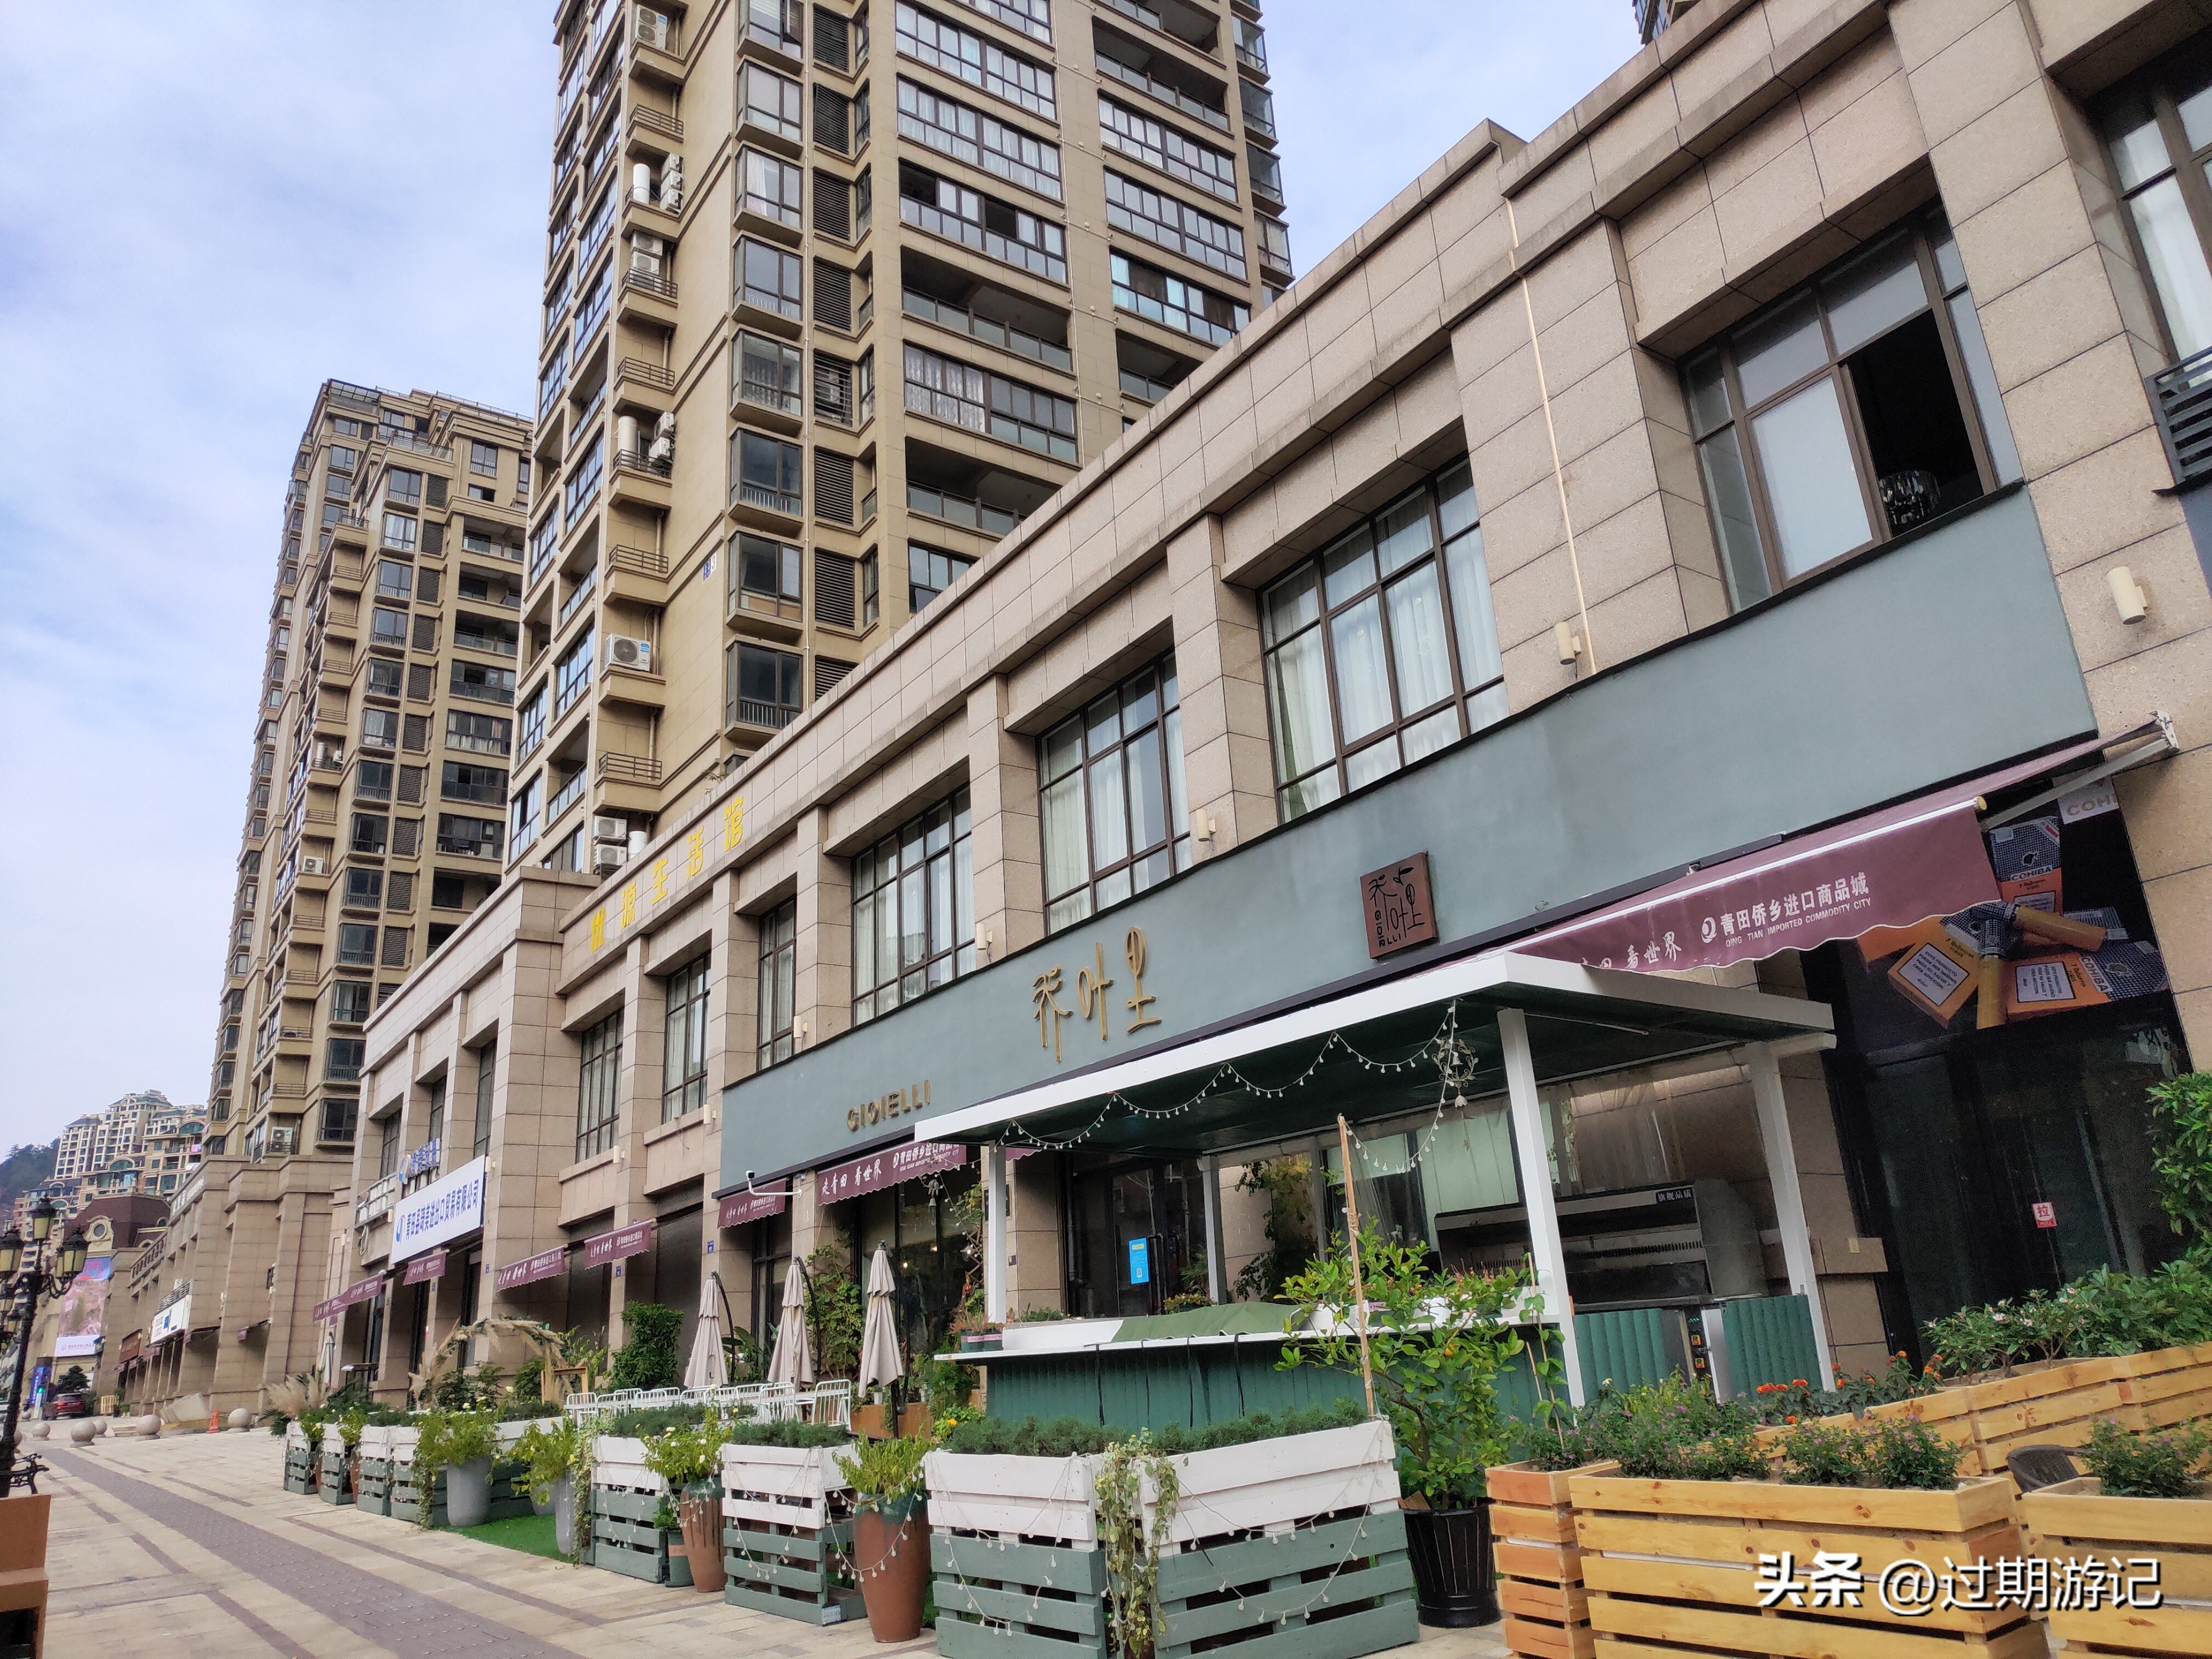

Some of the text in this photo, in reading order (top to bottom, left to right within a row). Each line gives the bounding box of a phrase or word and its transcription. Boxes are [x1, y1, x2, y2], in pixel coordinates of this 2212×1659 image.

[2011, 866, 2052, 882] COHIBA
[1720, 872, 1869, 936] 青田侨乡进口商品城
[1746, 929, 1764, 941] TIAN
[1767, 918, 1803, 935] IMPORTED
[1805, 902, 1851, 924] COMMODITY
[1853, 897, 1872, 910] CITY
[1625, 931, 1683, 969] 看世界
[2081, 957, 2111, 993] COHIBA
[847, 1078, 931, 1132] GIOIELLI
[821, 1172, 847, 1196] 走青田
[854, 1158, 882, 1186] 看世界
[2037, 1204, 2050, 1218] 拉
